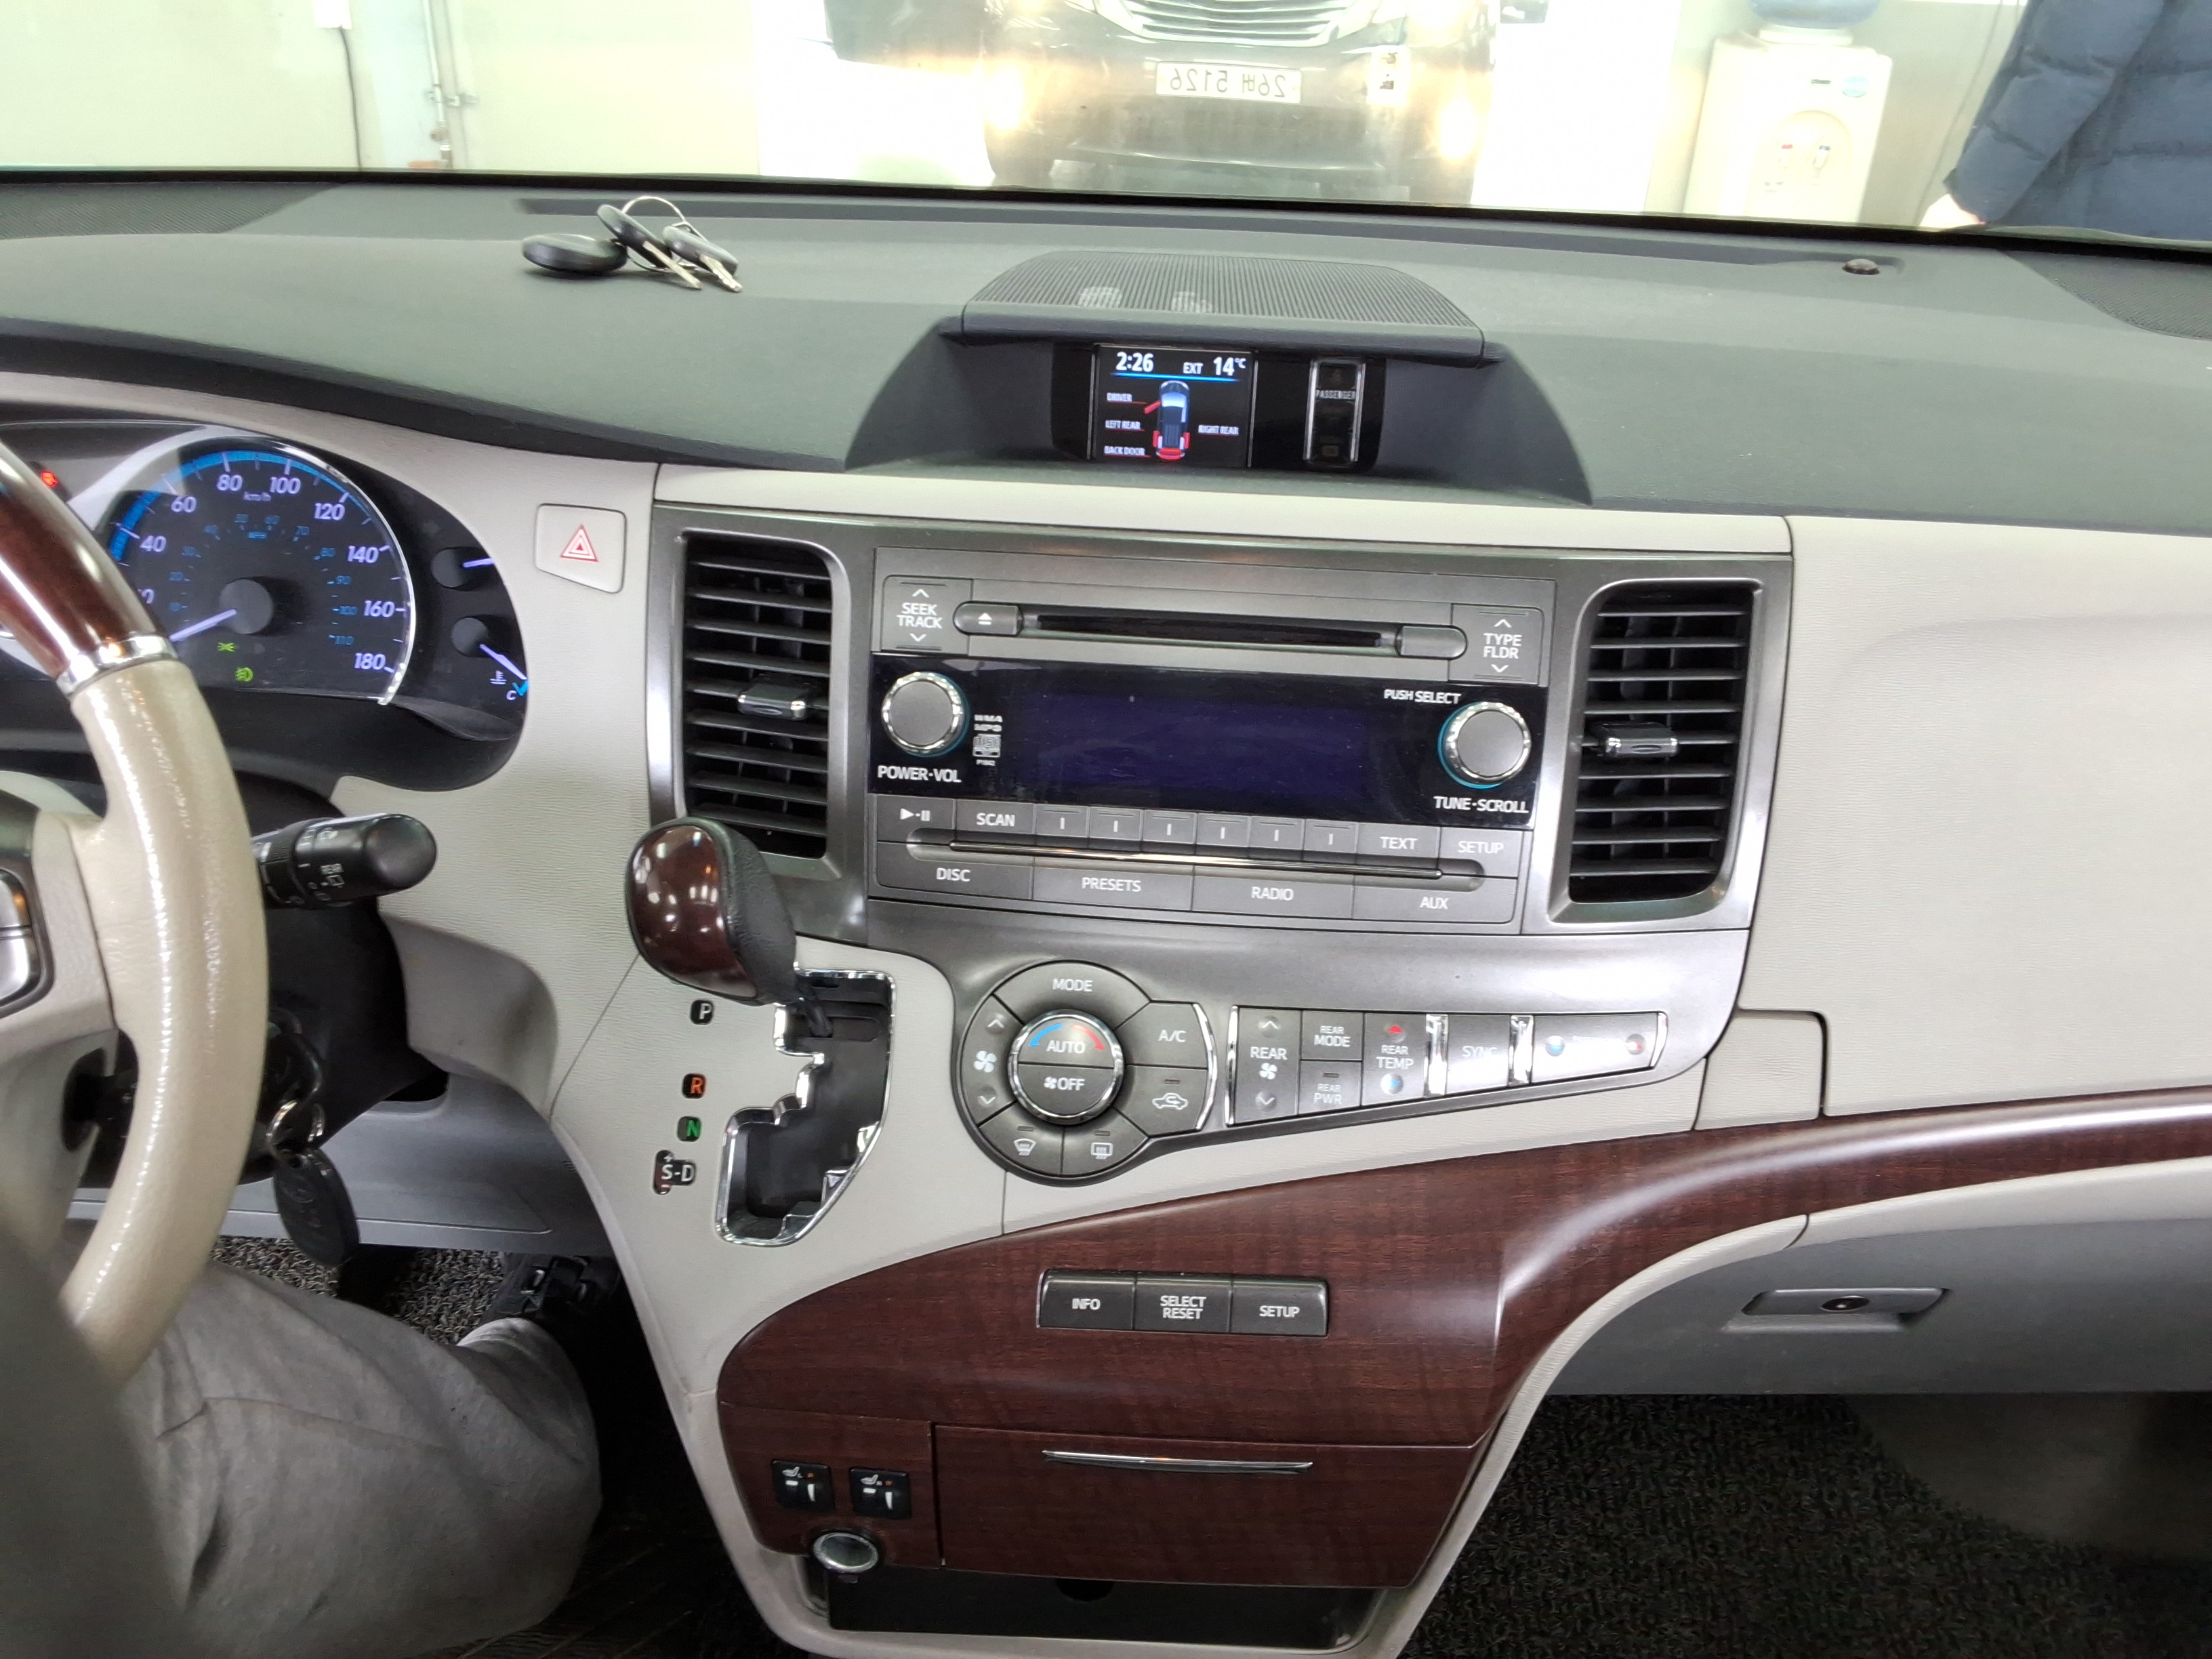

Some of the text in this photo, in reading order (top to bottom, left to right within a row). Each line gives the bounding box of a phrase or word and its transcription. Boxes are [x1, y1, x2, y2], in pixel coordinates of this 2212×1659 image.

[1115, 352, 1153, 371] 2:26
[1183, 362, 1204, 374] EXT
[217, 474, 243, 491] 80
[270, 476, 301, 494] 100
[171, 496, 197, 512] 60
[314, 503, 345, 520] 120
[140, 535, 167, 552] 40
[347, 546, 379, 563] 140
[364, 600, 395, 617] 160
[901, 602, 937, 617] SEEK
[897, 615, 943, 629] TRACK
[1483, 633, 1522, 647] TYPE
[1483, 646, 1519, 659] FLDR
[354, 653, 386, 670] 180
[506, 690, 517, 700] C
[1384, 689, 1461, 704] PUSH SELECT
[977, 813, 1015, 827] SCAN
[1380, 836, 1418, 851] TEXT
[1458, 840, 1504, 855] SETUP
[936, 868, 971, 882] DISC
[1082, 877, 1141, 893] PRESETS
[1251, 886, 1294, 901] RADIO
[1420, 897, 1449, 909] AUX
[1052, 979, 1093, 992] MODE
[699, 1003, 712, 1019] P
[1158, 1029, 1186, 1042] A/C
[1320, 1025, 1345, 1034] REAR
[1046, 1040, 1086, 1054] AUTO
[1313, 1035, 1351, 1047] MODE
[1250, 1046, 1288, 1060] REAR
[1381, 1045, 1409, 1054] REAR
[1376, 1057, 1414, 1069] TEMP
[690, 1077, 703, 1094] R
[1060, 1078, 1084, 1090] OFF
[1317, 1084, 1341, 1092] REAR
[1313, 1093, 1343, 1105] PWR
[685, 1120, 699, 1137] N
[1072, 1298, 1101, 1310] INFO
[1160, 1295, 1206, 1308] SELECT
[1163, 1307, 1203, 1320] RESET
[1259, 1305, 1300, 1318] SETUP
